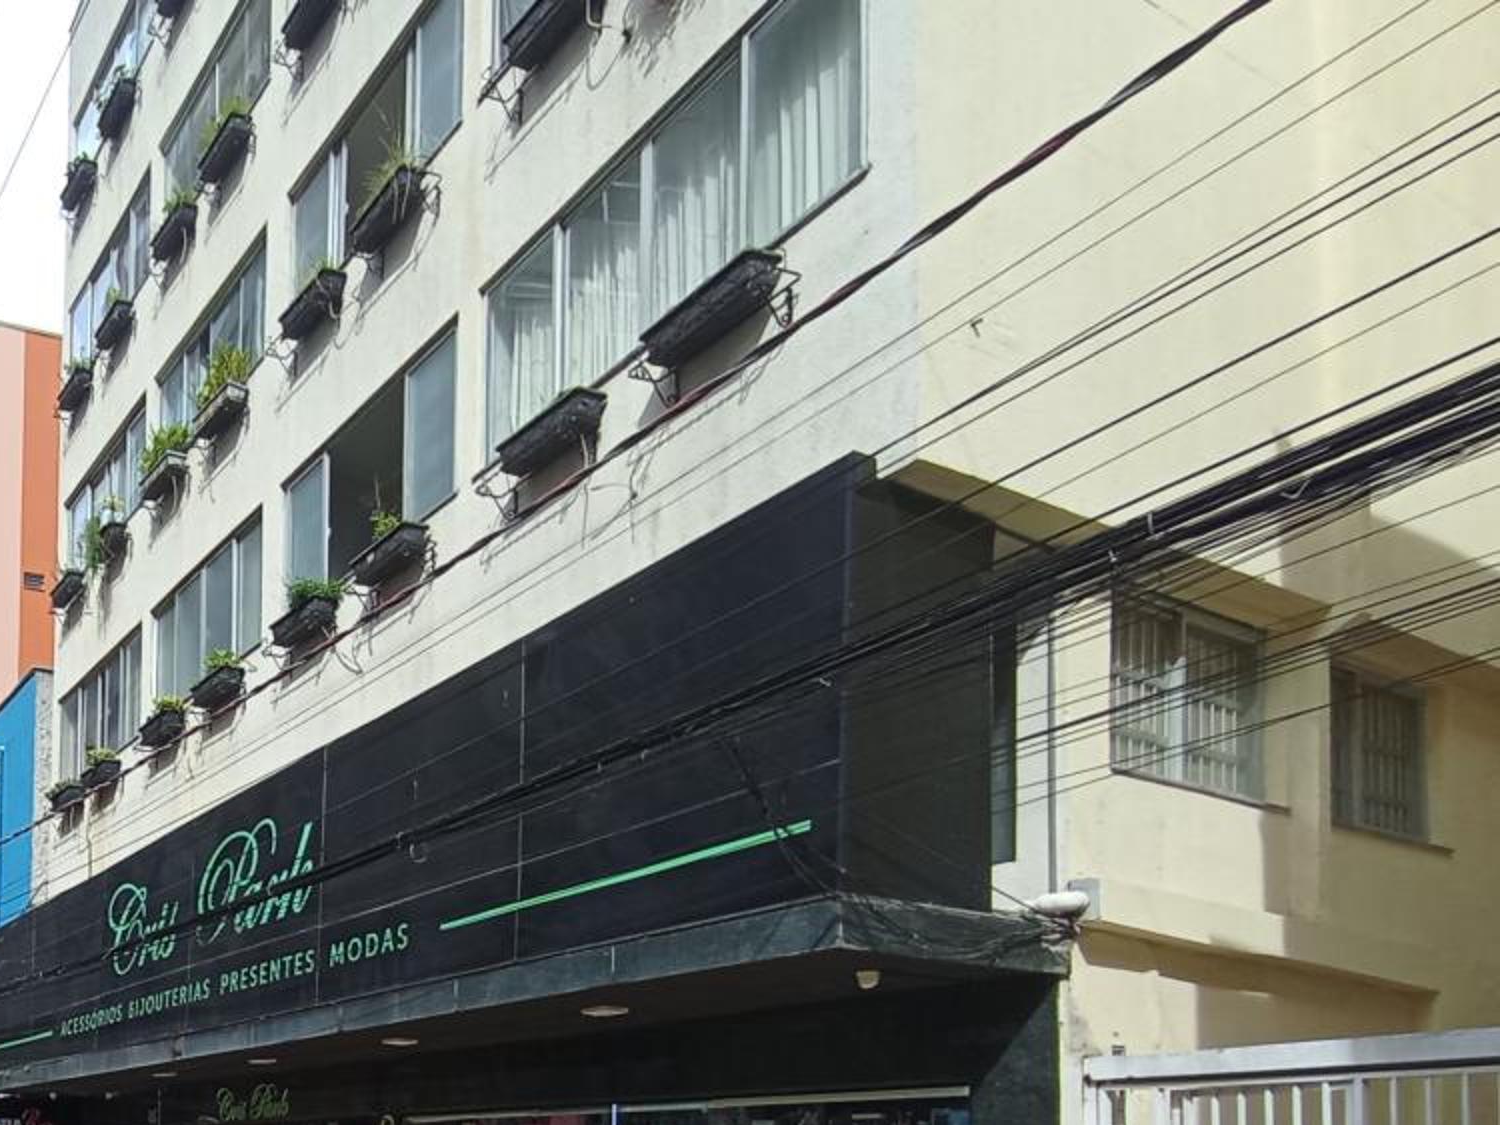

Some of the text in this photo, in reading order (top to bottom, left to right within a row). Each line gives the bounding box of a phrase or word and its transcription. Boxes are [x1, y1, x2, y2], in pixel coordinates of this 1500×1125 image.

[59, 922, 411, 1038] ACESSÓRIOS BIJOUTERIAS PRESENTES MODAS
